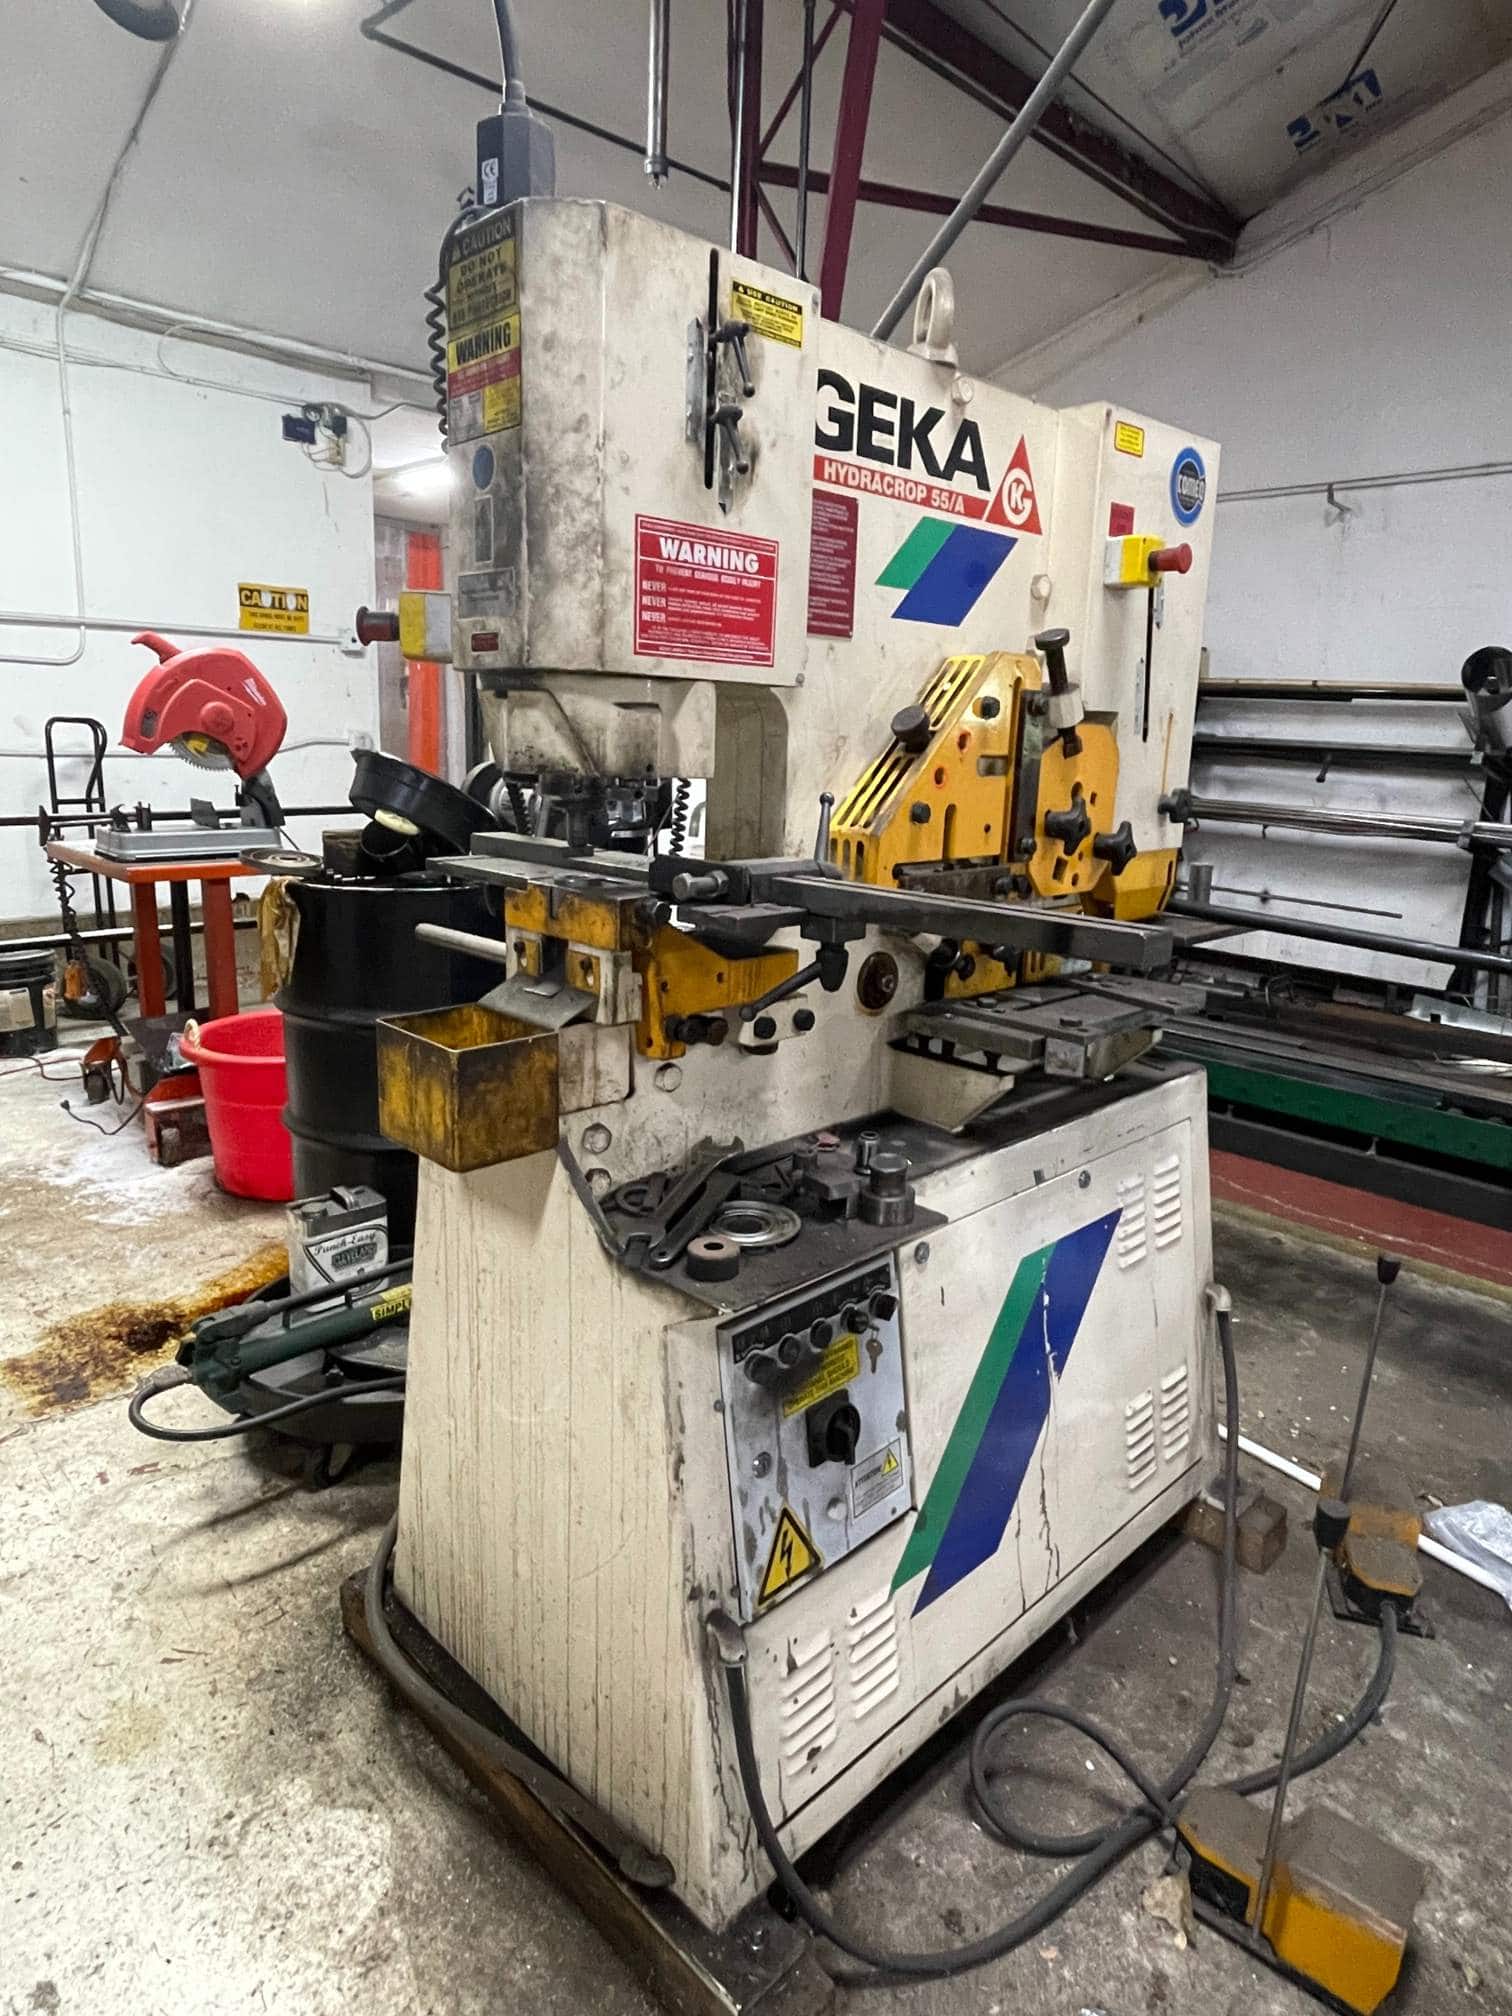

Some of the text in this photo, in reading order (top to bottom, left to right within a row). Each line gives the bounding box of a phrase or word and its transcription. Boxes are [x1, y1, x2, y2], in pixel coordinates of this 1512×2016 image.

[460, 214, 513, 256] CAUTION
[479, 247, 502, 270] NOT
[455, 320, 512, 366] WARNING
[815, 368, 991, 492] GEKA
[823, 459, 966, 515] HYDRACROP 55/A
[659, 537, 760, 573] WARNING
[240, 589, 308, 611] CAUTION
[641, 579, 667, 592] NEVER
[641, 595, 666, 608] NEVER
